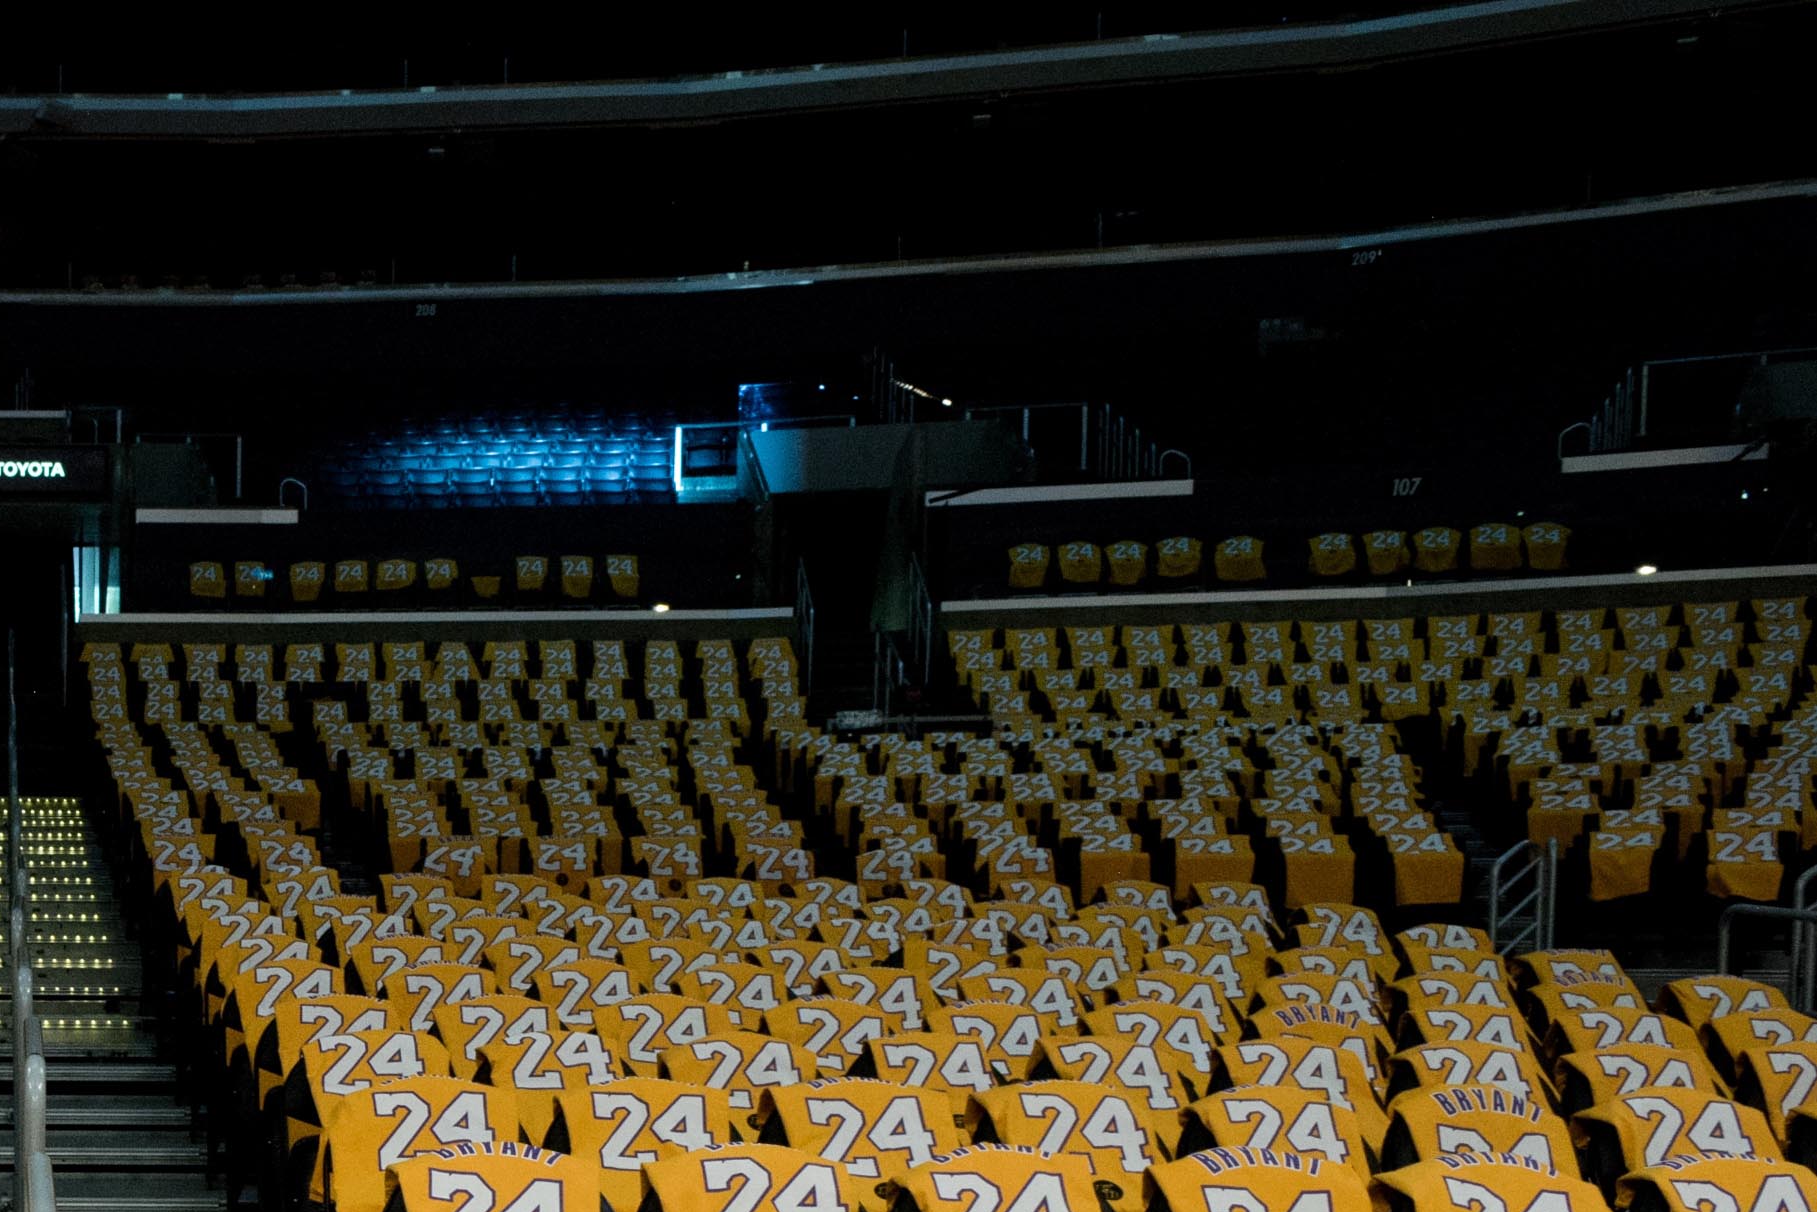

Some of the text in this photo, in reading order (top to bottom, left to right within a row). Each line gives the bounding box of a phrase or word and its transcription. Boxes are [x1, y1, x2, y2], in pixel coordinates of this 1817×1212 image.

[1392, 477, 1423, 497] 107
[152, 815, 194, 838] 24
[1080, 832, 1133, 852] 24
[1279, 835, 1335, 854] 24
[1596, 832, 1654, 849] 24
[1716, 831, 1778, 862] 24
[154, 837, 206, 873] 24
[602, 877, 663, 914] 24
[580, 913, 650, 959] 24
[552, 971, 639, 1025] 24
[988, 977, 1078, 1032] 24
[1277, 1002, 1364, 1029] BRYANT
[621, 1005, 714, 1062] 24
[1580, 1008, 1672, 1049] 24
[311, 1031, 423, 1095] 24
[505, 1029, 618, 1089] 24
[686, 1040, 800, 1089] 24
[884, 1043, 993, 1092] 24
[1239, 1041, 1352, 1107] 24
[1433, 1080, 1542, 1122] BRYANT
[374, 1092, 494, 1170] 24
[593, 1093, 721, 1170] 24
[807, 1097, 943, 1177] 24
[1015, 1094, 1152, 1172] 24
[1224, 1092, 1353, 1171] 24
[1625, 1097, 1758, 1164] 24
[1188, 1141, 1321, 1176] BRYANT
